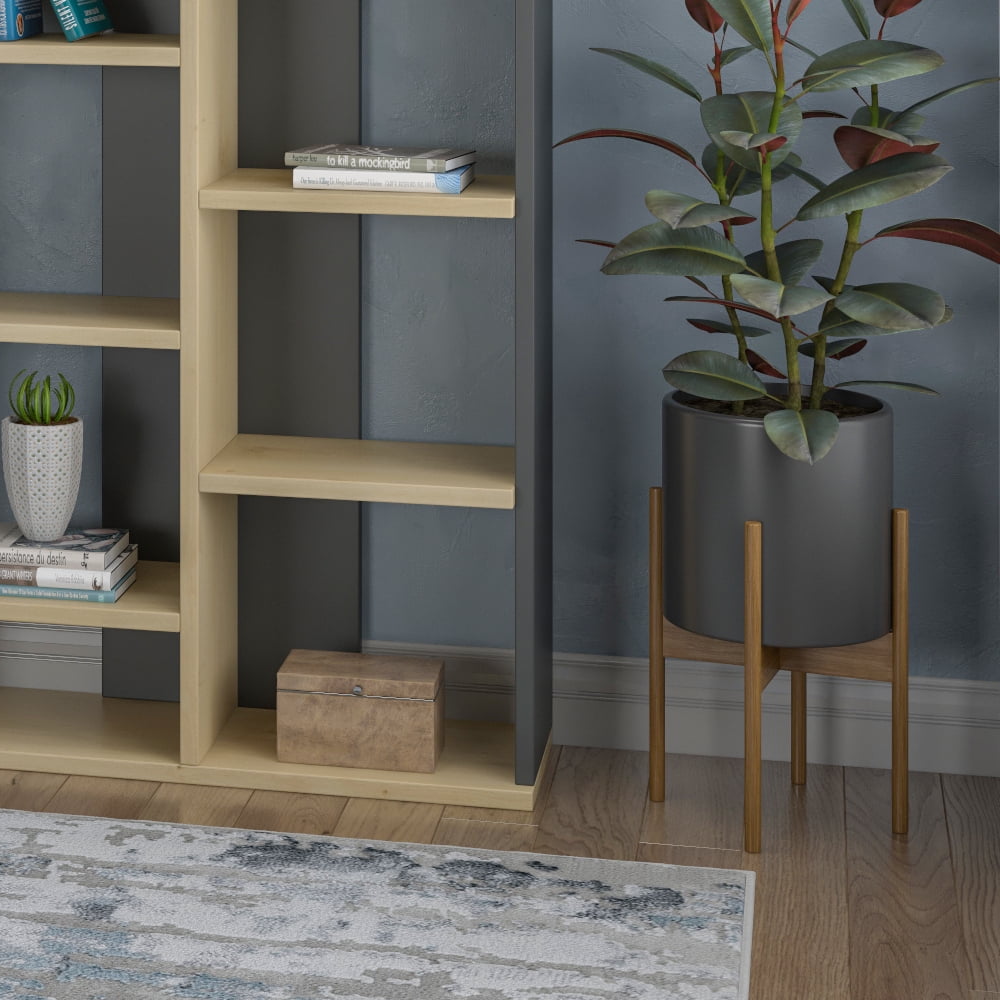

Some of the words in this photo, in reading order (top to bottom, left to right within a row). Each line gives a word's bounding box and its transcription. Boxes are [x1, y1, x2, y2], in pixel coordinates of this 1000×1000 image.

[57, 5, 78, 30] SILENT
[326, 156, 335, 166] to
[338, 155, 348, 166] kill
[350, 158, 356, 167] a
[359, 156, 411, 170] mockingbird
[36, 550, 44, 565] du
[47, 551, 66, 566] destin
